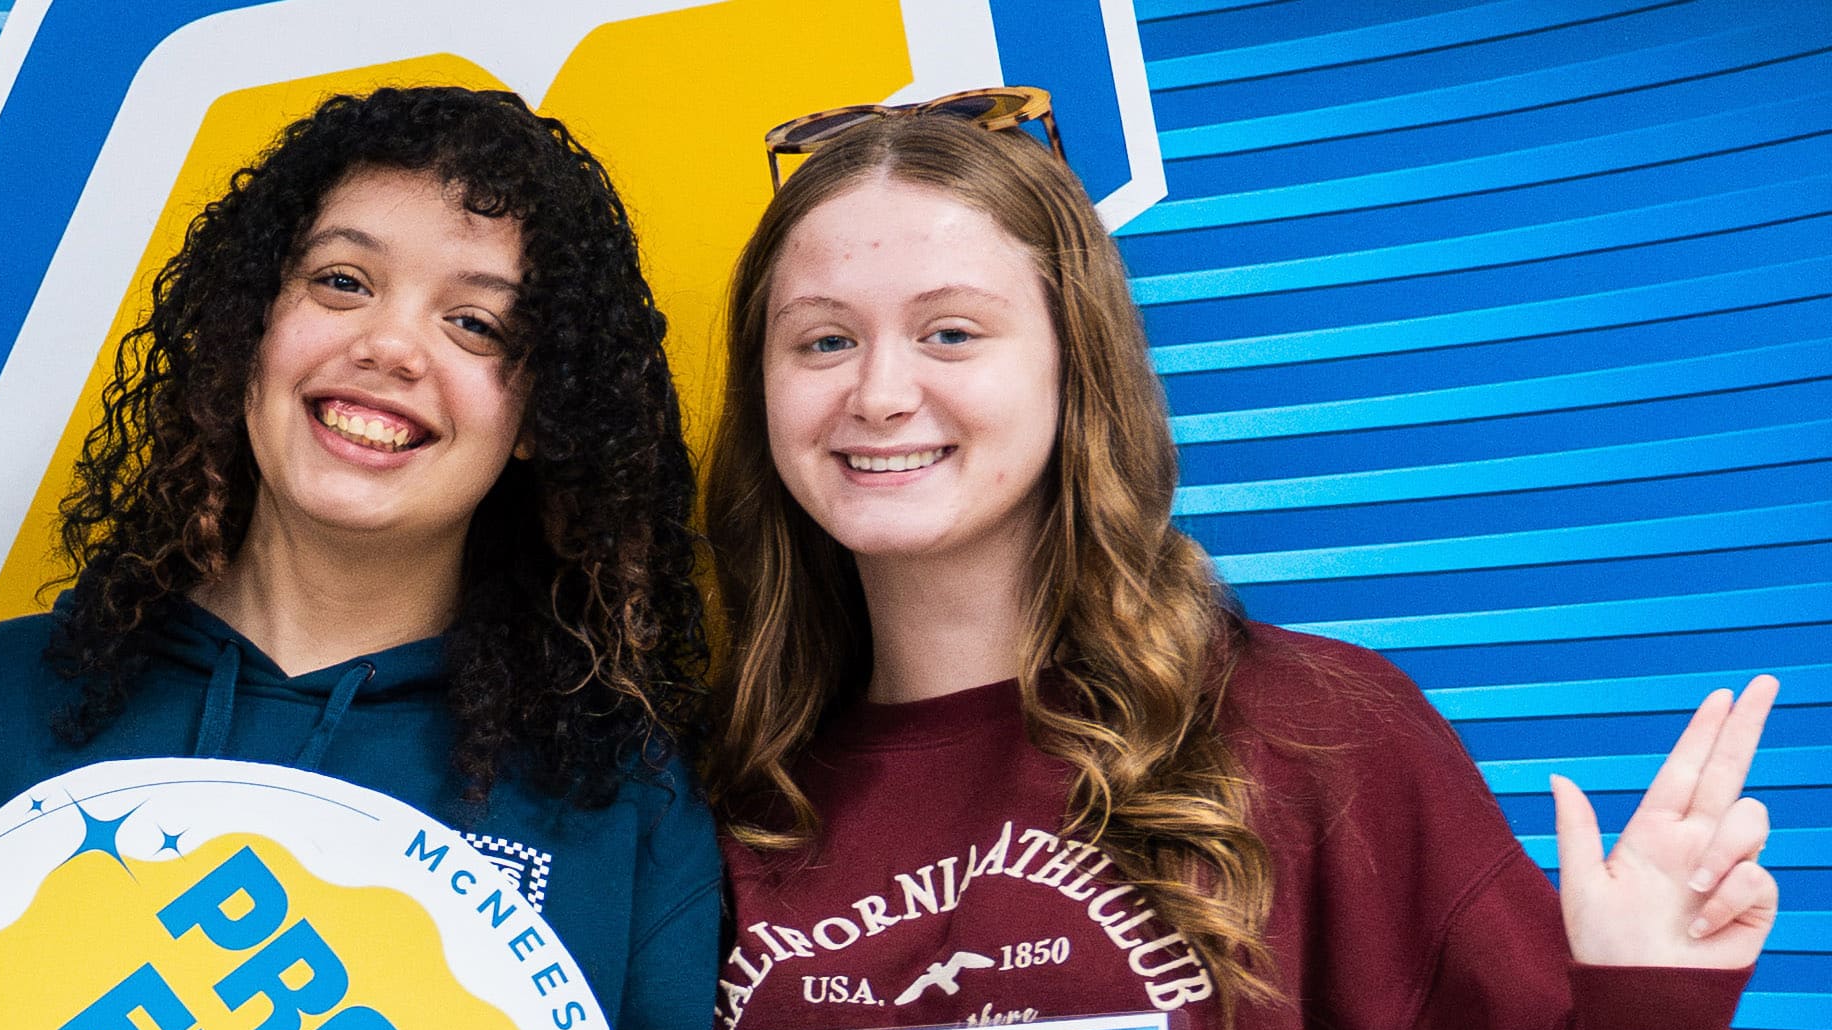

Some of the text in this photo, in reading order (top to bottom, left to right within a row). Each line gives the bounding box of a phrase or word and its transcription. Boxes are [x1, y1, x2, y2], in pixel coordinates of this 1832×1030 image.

[801, 936, 1070, 1007] USA. 1850
[1087, 884, 1213, 1011] CLUB
